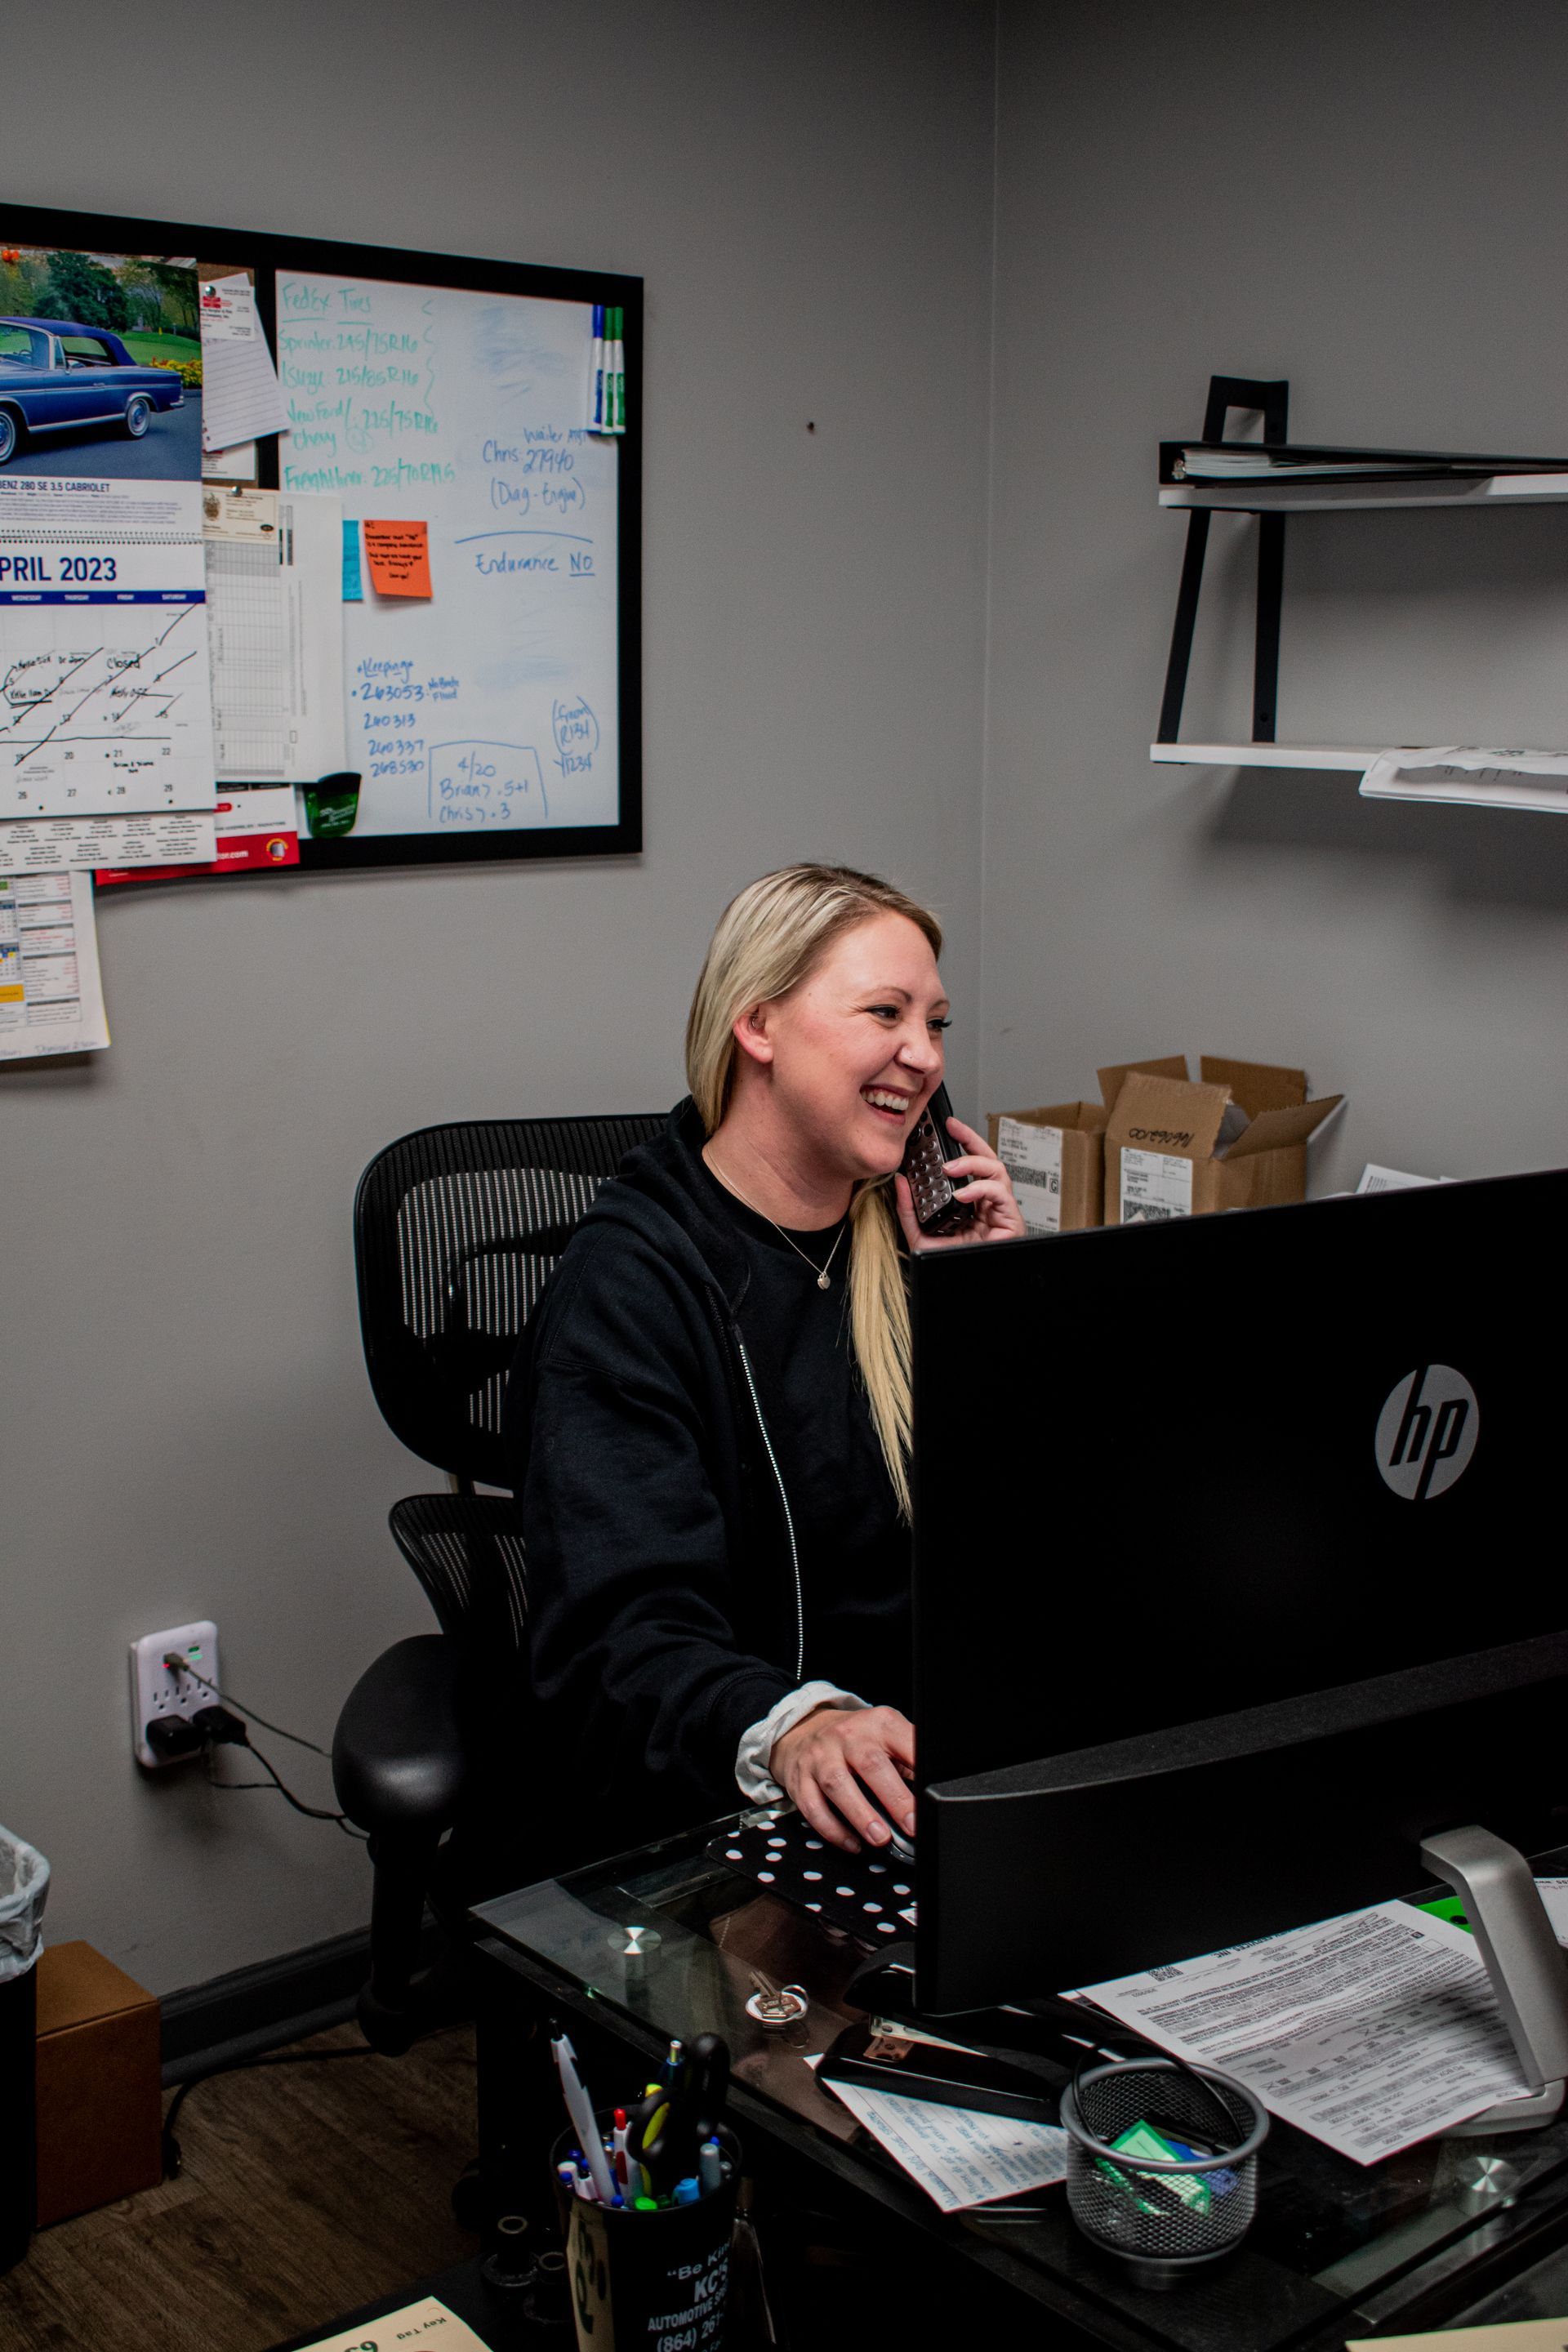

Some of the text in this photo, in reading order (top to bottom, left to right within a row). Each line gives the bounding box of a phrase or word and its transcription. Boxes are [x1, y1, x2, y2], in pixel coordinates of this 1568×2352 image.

[20, 481, 36, 491] 280
[38, 482, 47, 491] SE
[51, 483, 63, 492] 3.5
[65, 483, 110, 493] CABRIOLET
[0, 557, 117, 581] PRIL 2023
[475, 552, 559, 575] Endurance
[107, 654, 140, 669] Closed
[65, 751, 74, 760] 20
[114, 750, 122, 758] 21
[162, 747, 171, 755] 22
[67, 789, 76, 797] 27
[164, 784, 173, 792] 29
[1388, 1364, 1469, 1500] hp
[648, 2297, 713, 2332] AUTOMOTIVE
[396, 2316, 448, 2341] Key Tag
[656, 2328, 698, 2352] (864)
